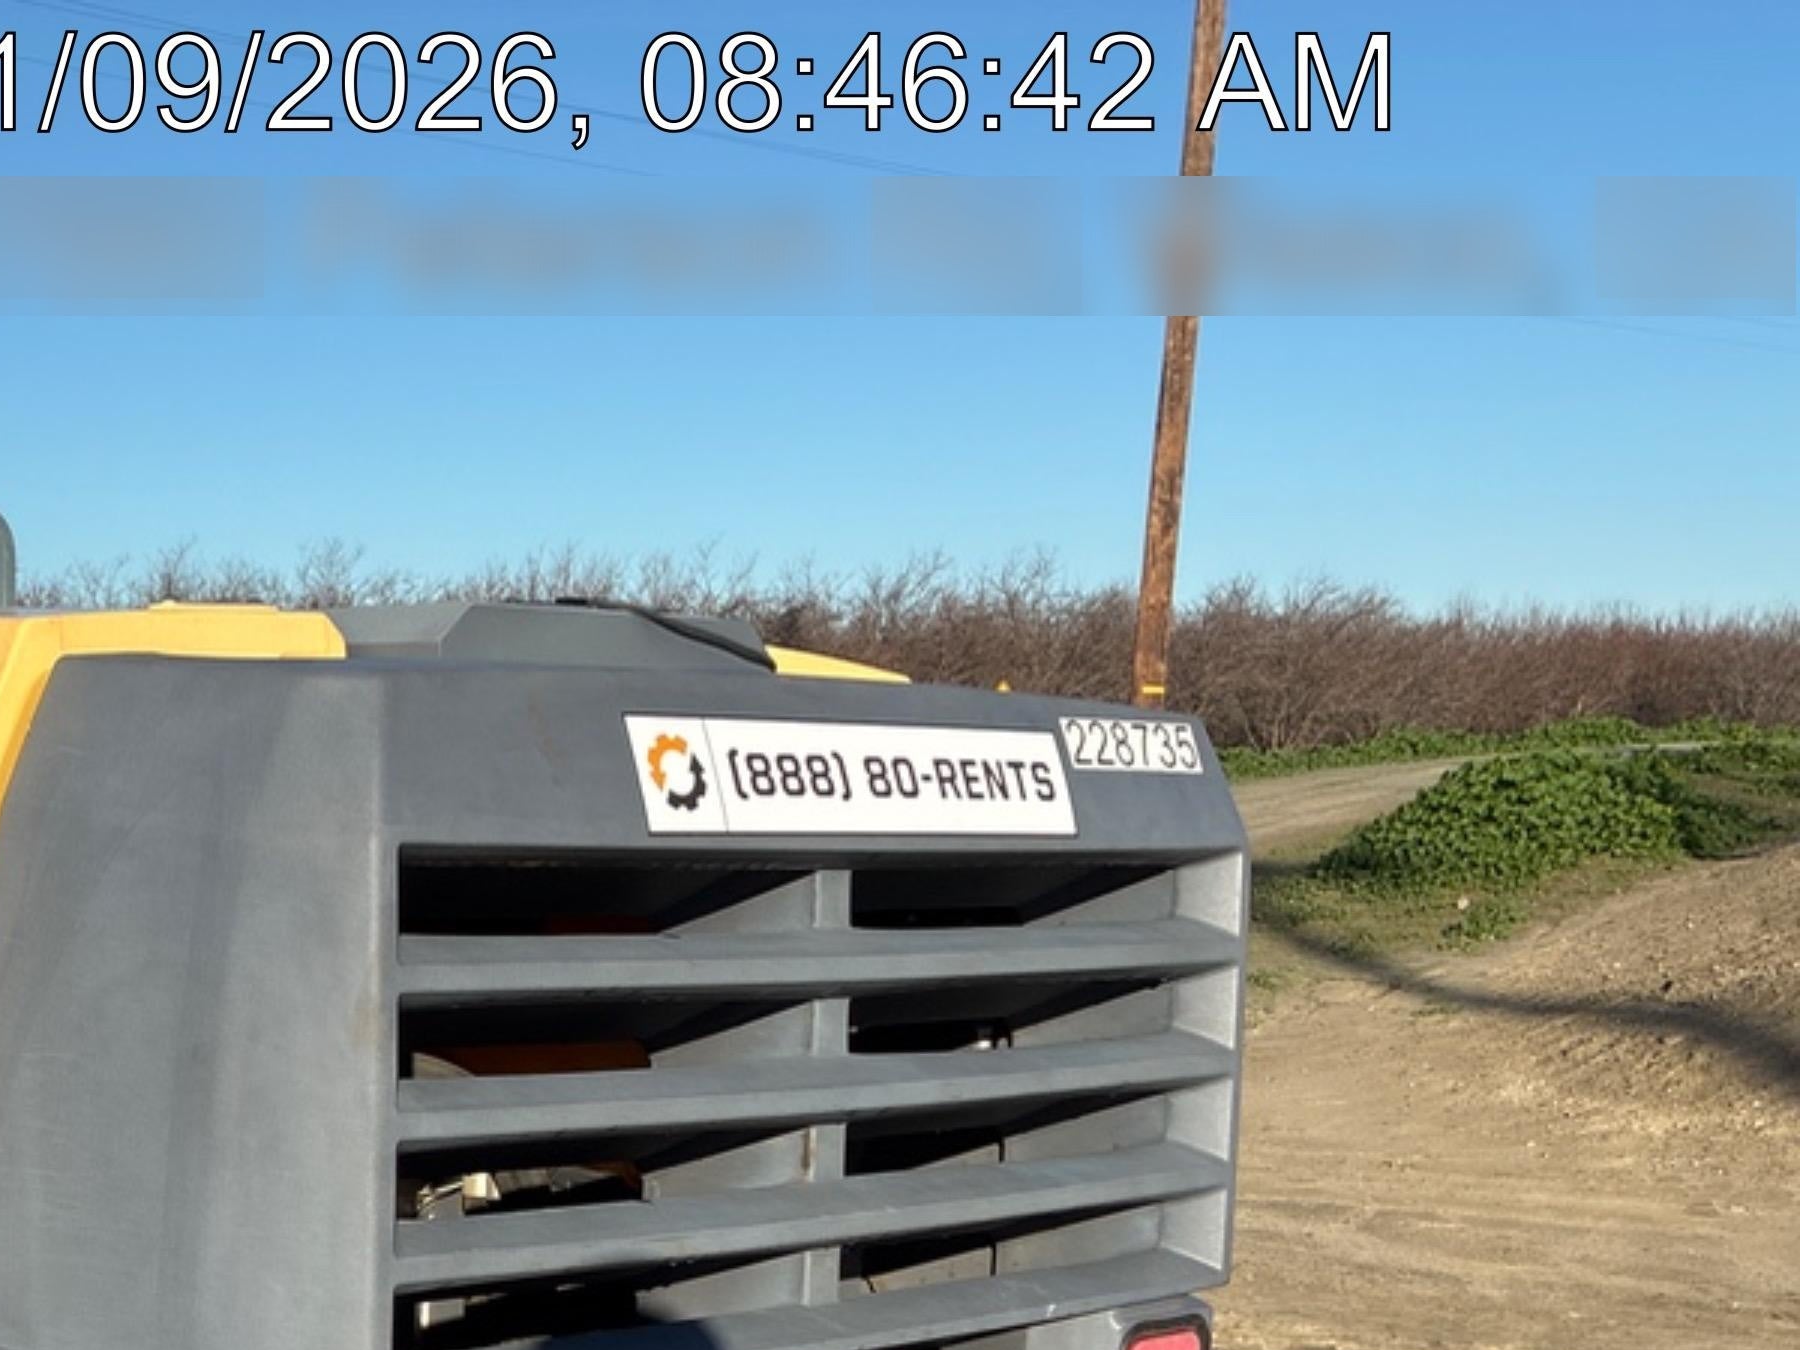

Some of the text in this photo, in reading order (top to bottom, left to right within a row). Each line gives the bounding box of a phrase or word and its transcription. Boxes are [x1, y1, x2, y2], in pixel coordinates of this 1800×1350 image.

[1067, 719, 1197, 768] 228735
[728, 747, 1056, 801] (888) 80-RENTS
